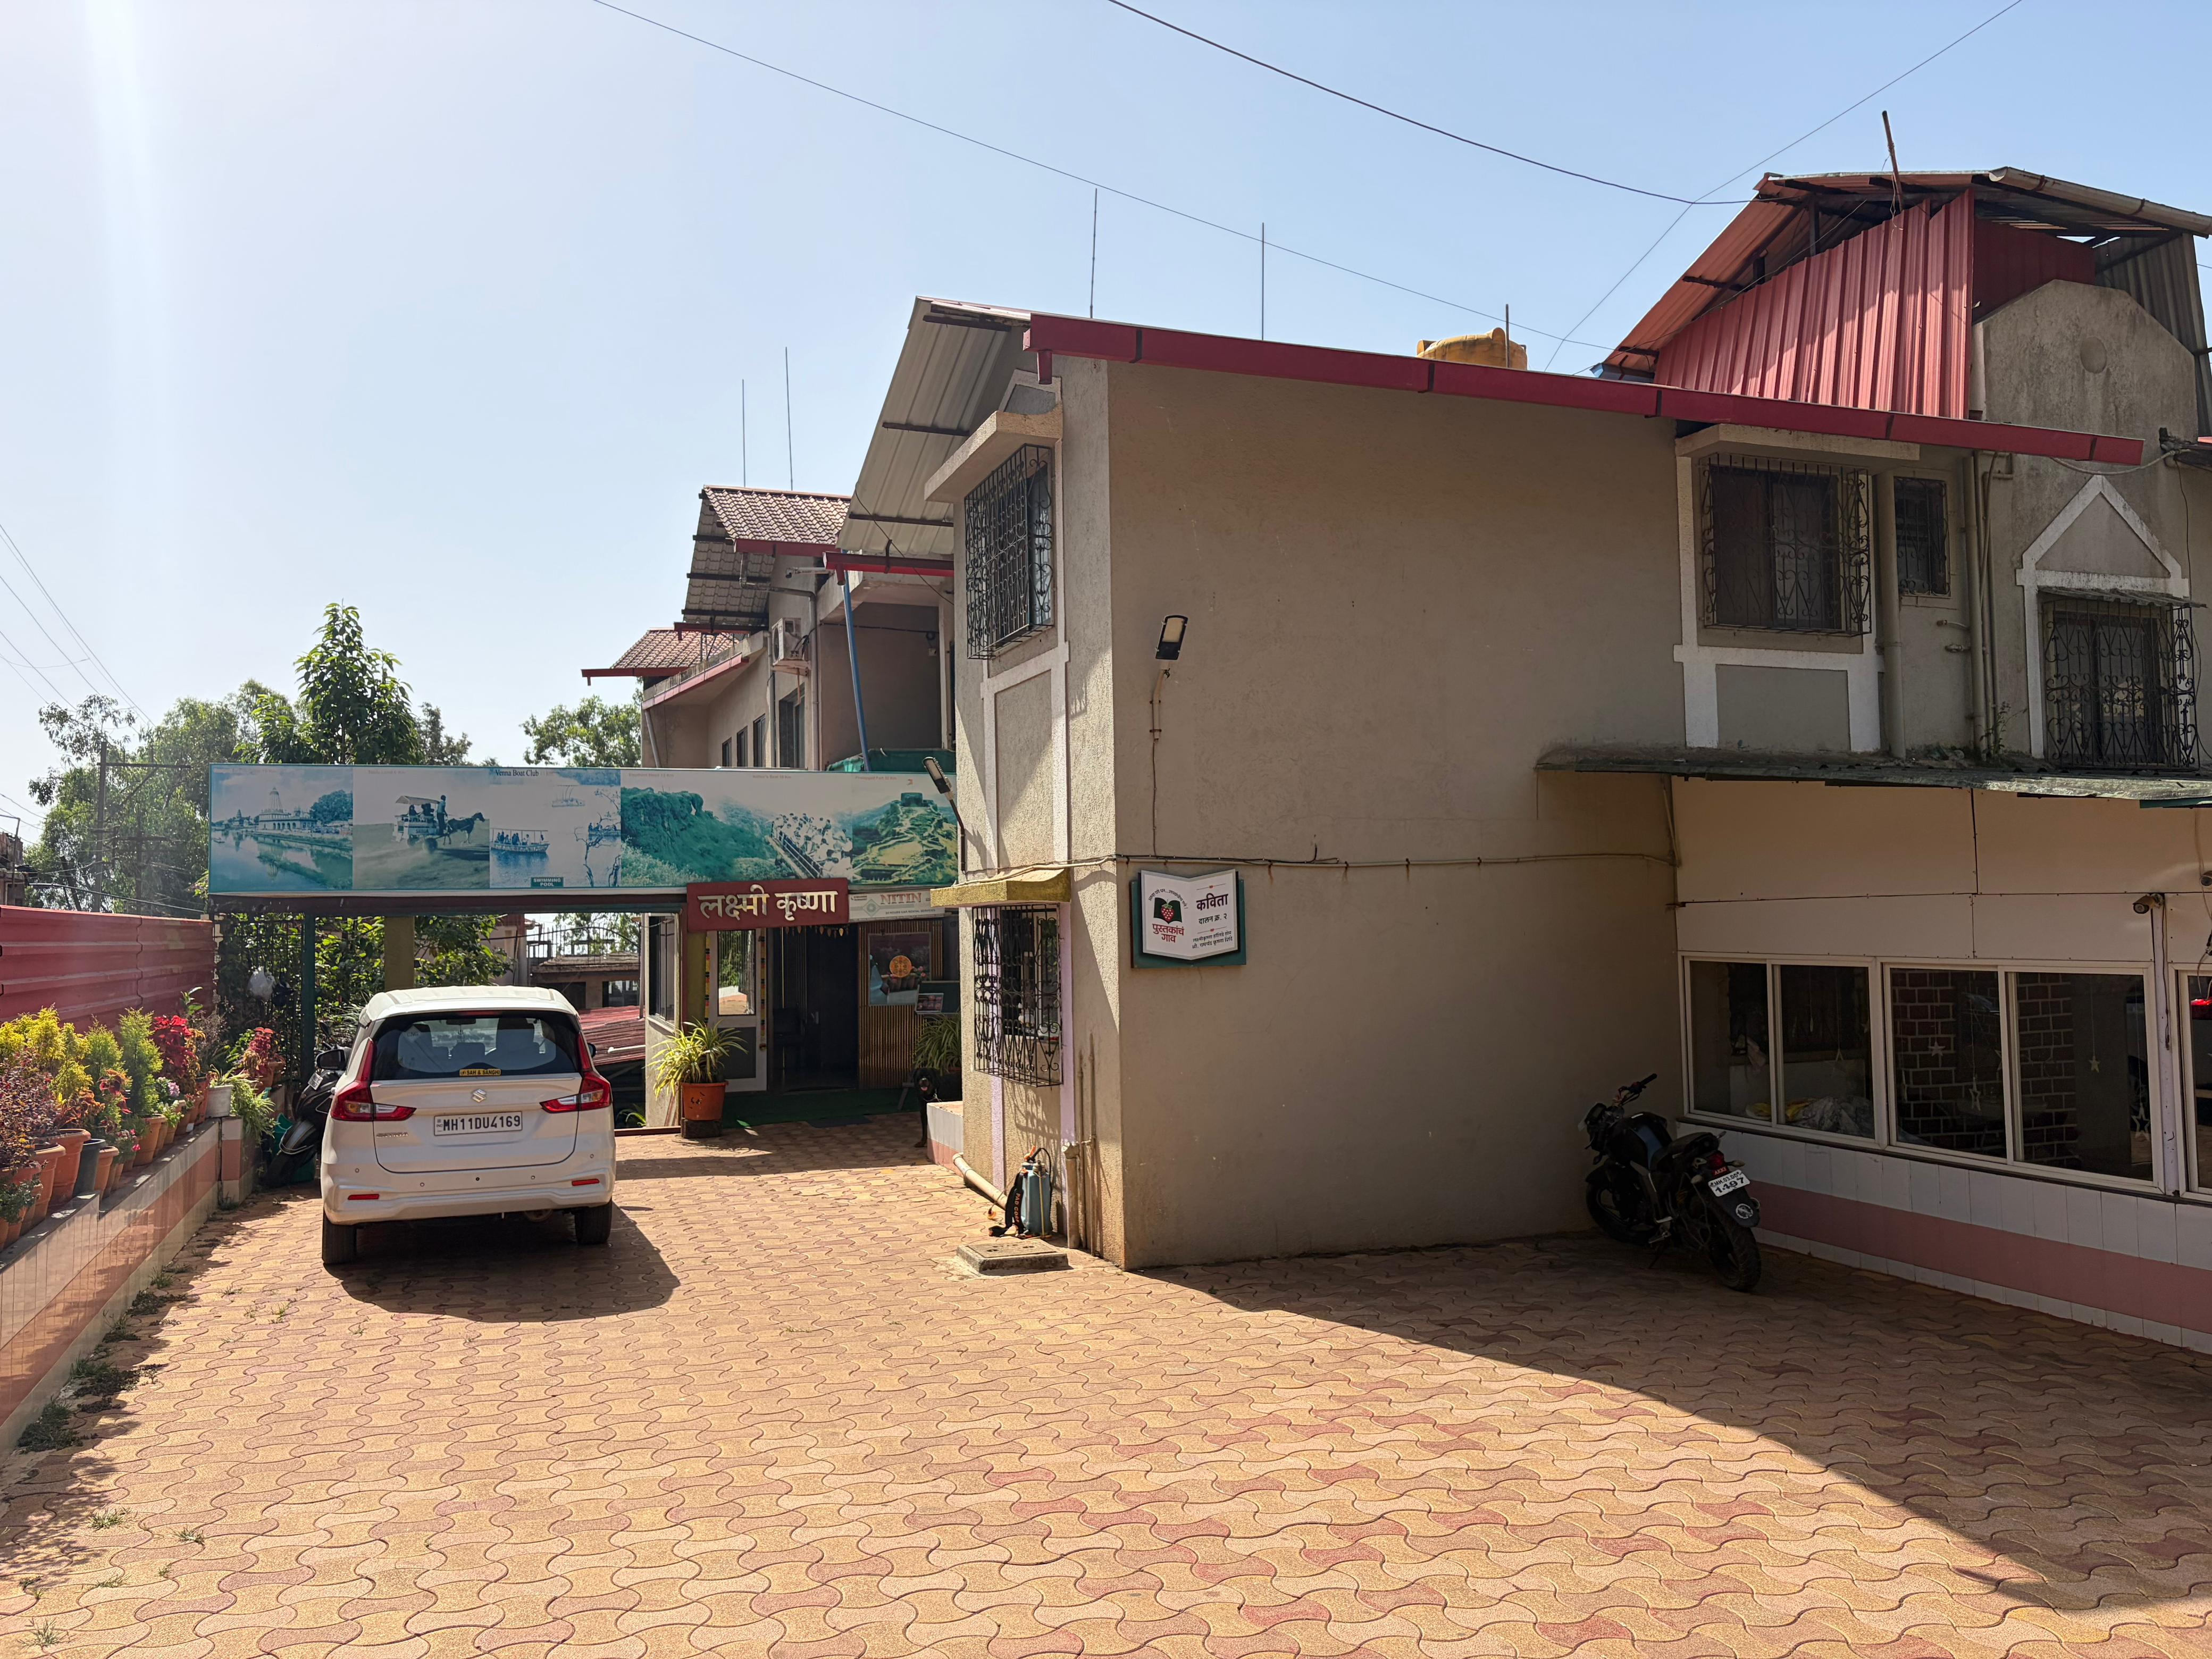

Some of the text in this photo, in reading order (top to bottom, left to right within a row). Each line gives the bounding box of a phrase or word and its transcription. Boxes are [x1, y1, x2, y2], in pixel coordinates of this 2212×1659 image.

[697, 884, 838, 921] लक्ष्मी कृष्णा
[881, 893, 921, 904] NITIN
[1196, 893, 1228, 911] कविता
[1199, 916, 1213, 924] दालन
[1152, 923, 1185, 936] पुस्तकांचं
[1161, 933, 1176, 943] गाव
[443, 1115, 521, 1131] MH11DU4169
